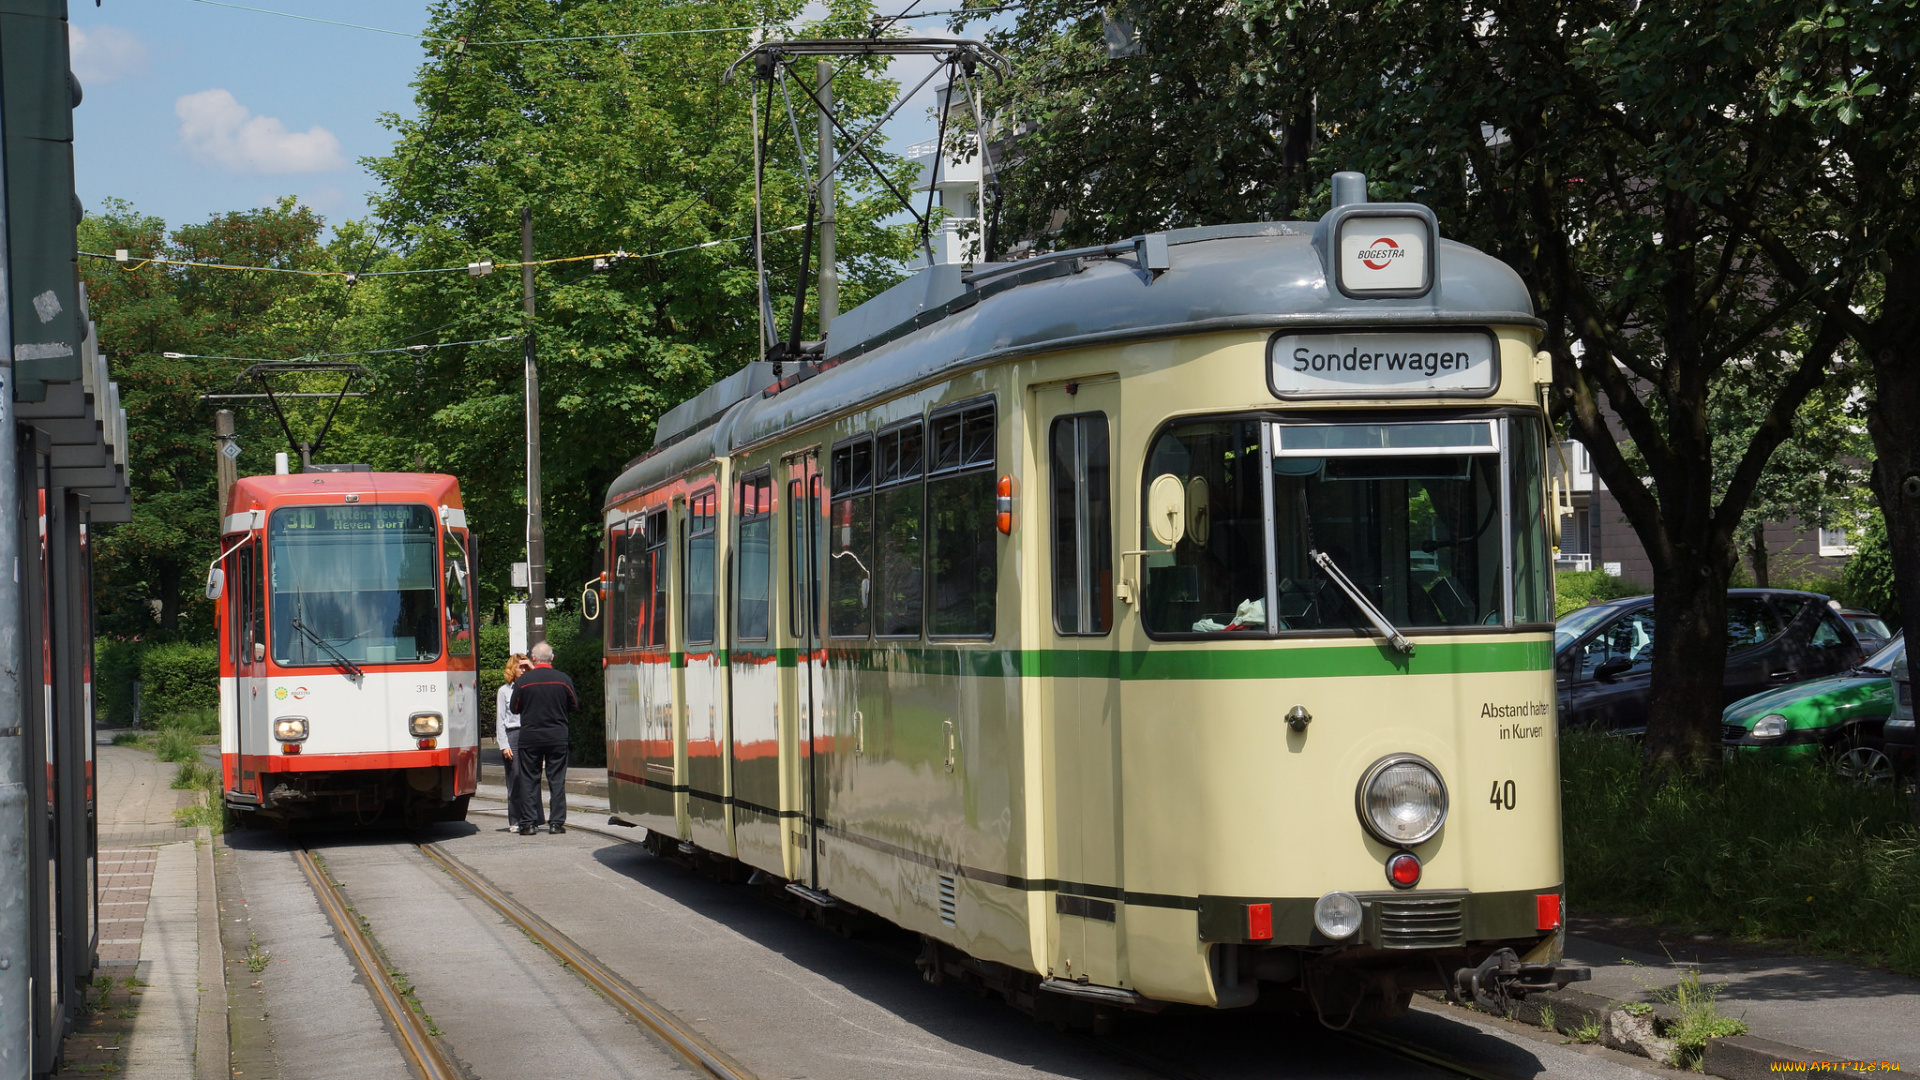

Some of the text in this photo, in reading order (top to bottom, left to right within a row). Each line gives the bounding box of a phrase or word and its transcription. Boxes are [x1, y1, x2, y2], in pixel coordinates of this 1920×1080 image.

[1358, 249, 1405, 259] BOGESTRA
[1293, 347, 1470, 377] Sonderwagen
[287, 510, 316, 529] 310
[334, 520, 371, 530] Heven
[416, 684, 437, 693] 311 B
[1480, 700, 1550, 718] Abstand halten
[1499, 723, 1543, 740] in Kurven
[1489, 779, 1517, 811] 40
